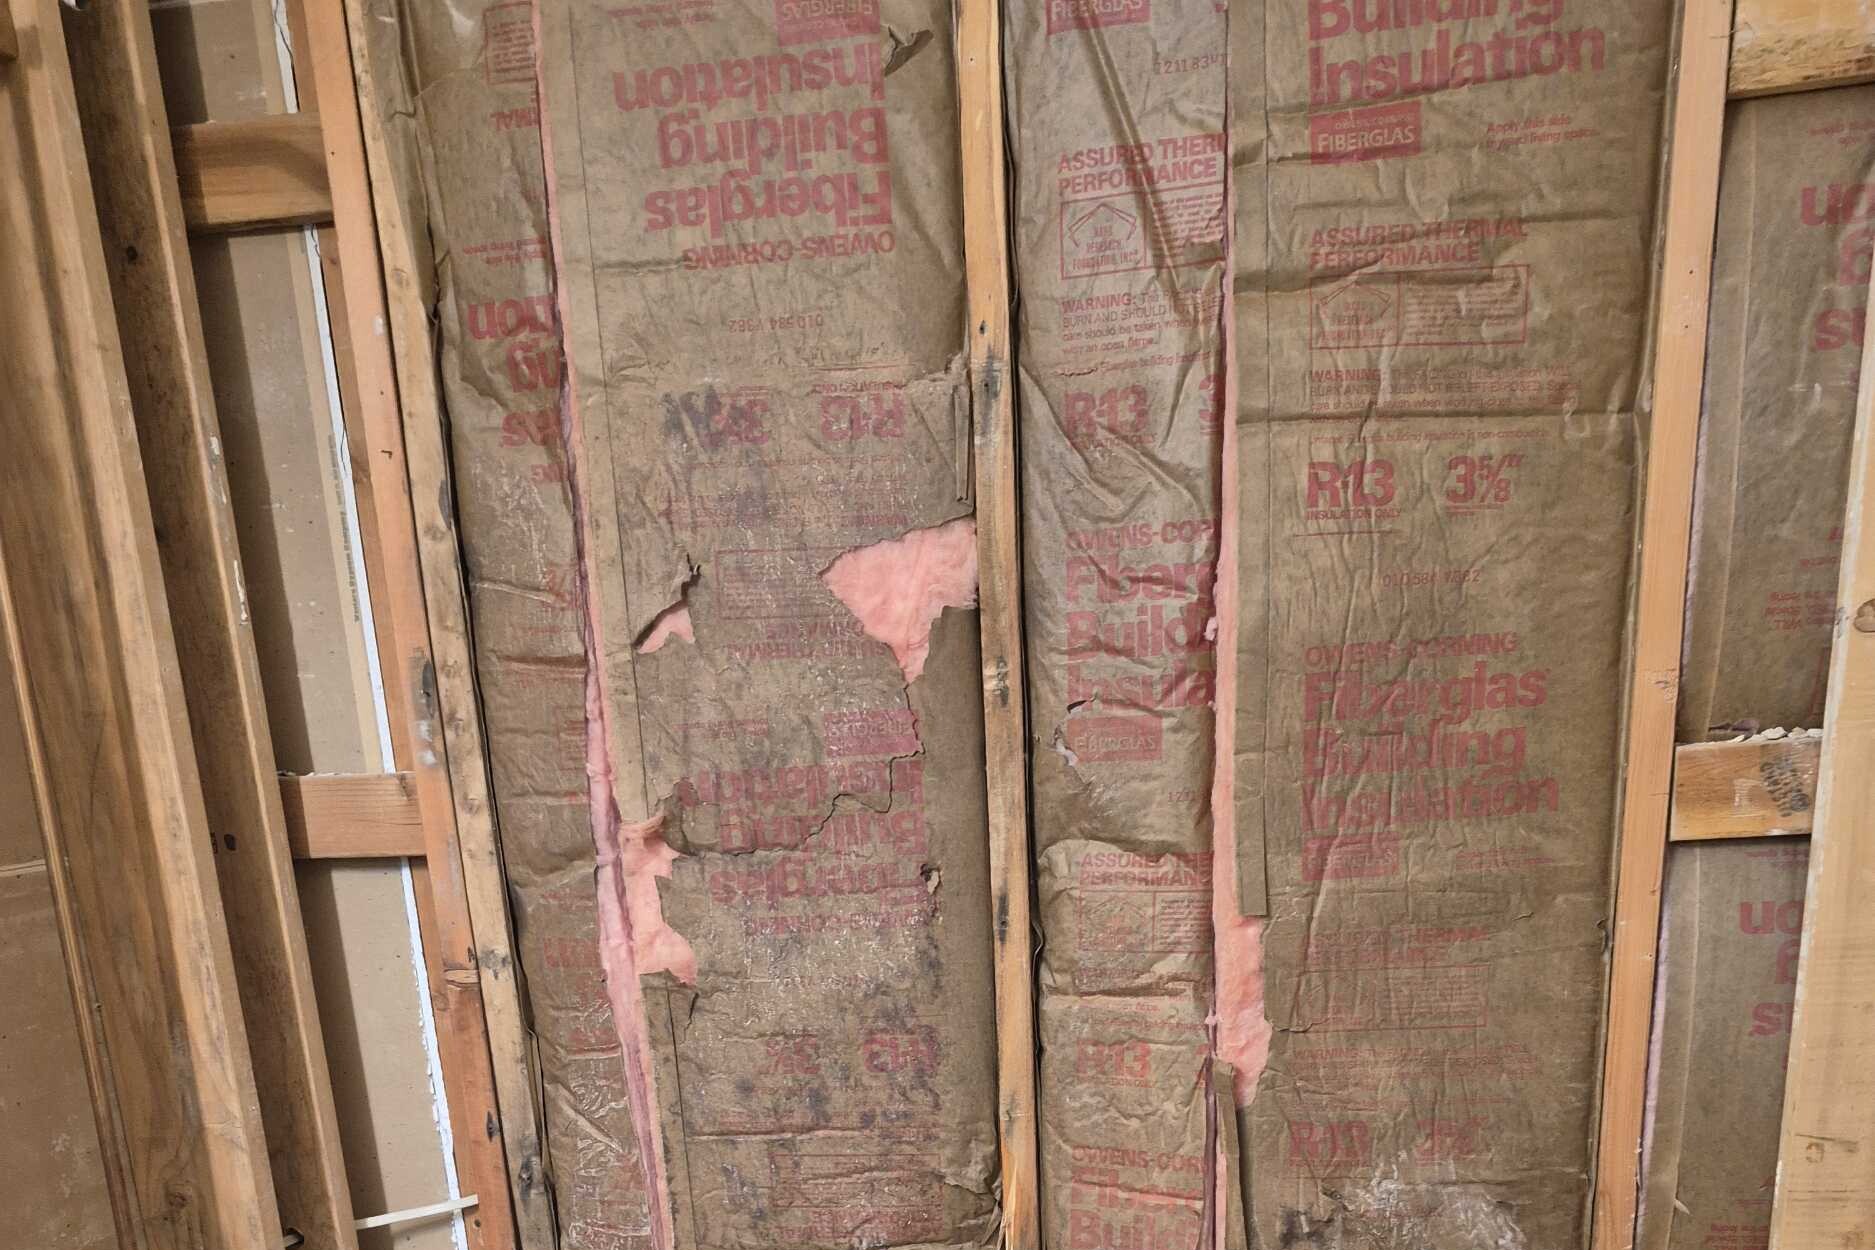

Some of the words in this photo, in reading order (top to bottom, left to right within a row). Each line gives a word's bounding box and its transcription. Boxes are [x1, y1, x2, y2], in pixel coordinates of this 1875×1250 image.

[613, 42, 886, 113] Insulation
[1310, 27, 1606, 107] Insulation
[657, 108, 889, 175] Building
[1057, 142, 1154, 174] ASSURED
[1316, 126, 1416, 153] FIBERGLAS
[644, 169, 892, 239] Fiberglas
[1057, 158, 1217, 196] PERFORMANCE
[681, 229, 897, 272] OWENS-CORNING
[1311, 223, 1417, 248] ASSURED
[1304, 660, 1549, 726] Fiberglas
[1303, 718, 1528, 780] Building
[1301, 775, 1561, 835] Insulation
